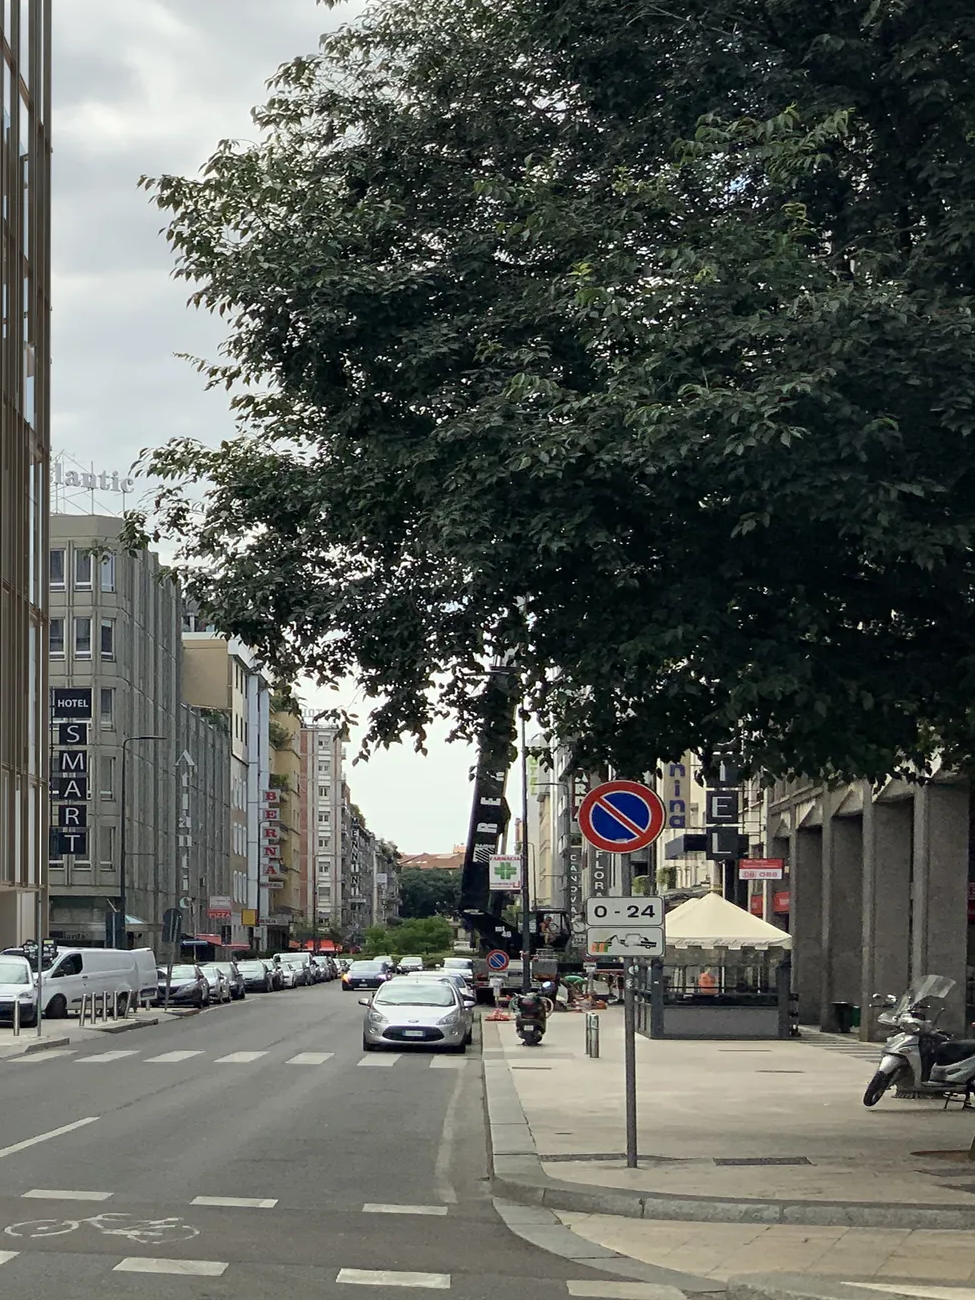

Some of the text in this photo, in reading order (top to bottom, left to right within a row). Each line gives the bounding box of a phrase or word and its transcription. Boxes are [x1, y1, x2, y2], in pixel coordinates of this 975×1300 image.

[50, 462, 134, 493] lantic
[57, 699, 89, 708] HOTEL
[61, 724, 85, 853] SMART
[264, 791, 277, 874] BERNA
[626, 905, 656, 918] 24
